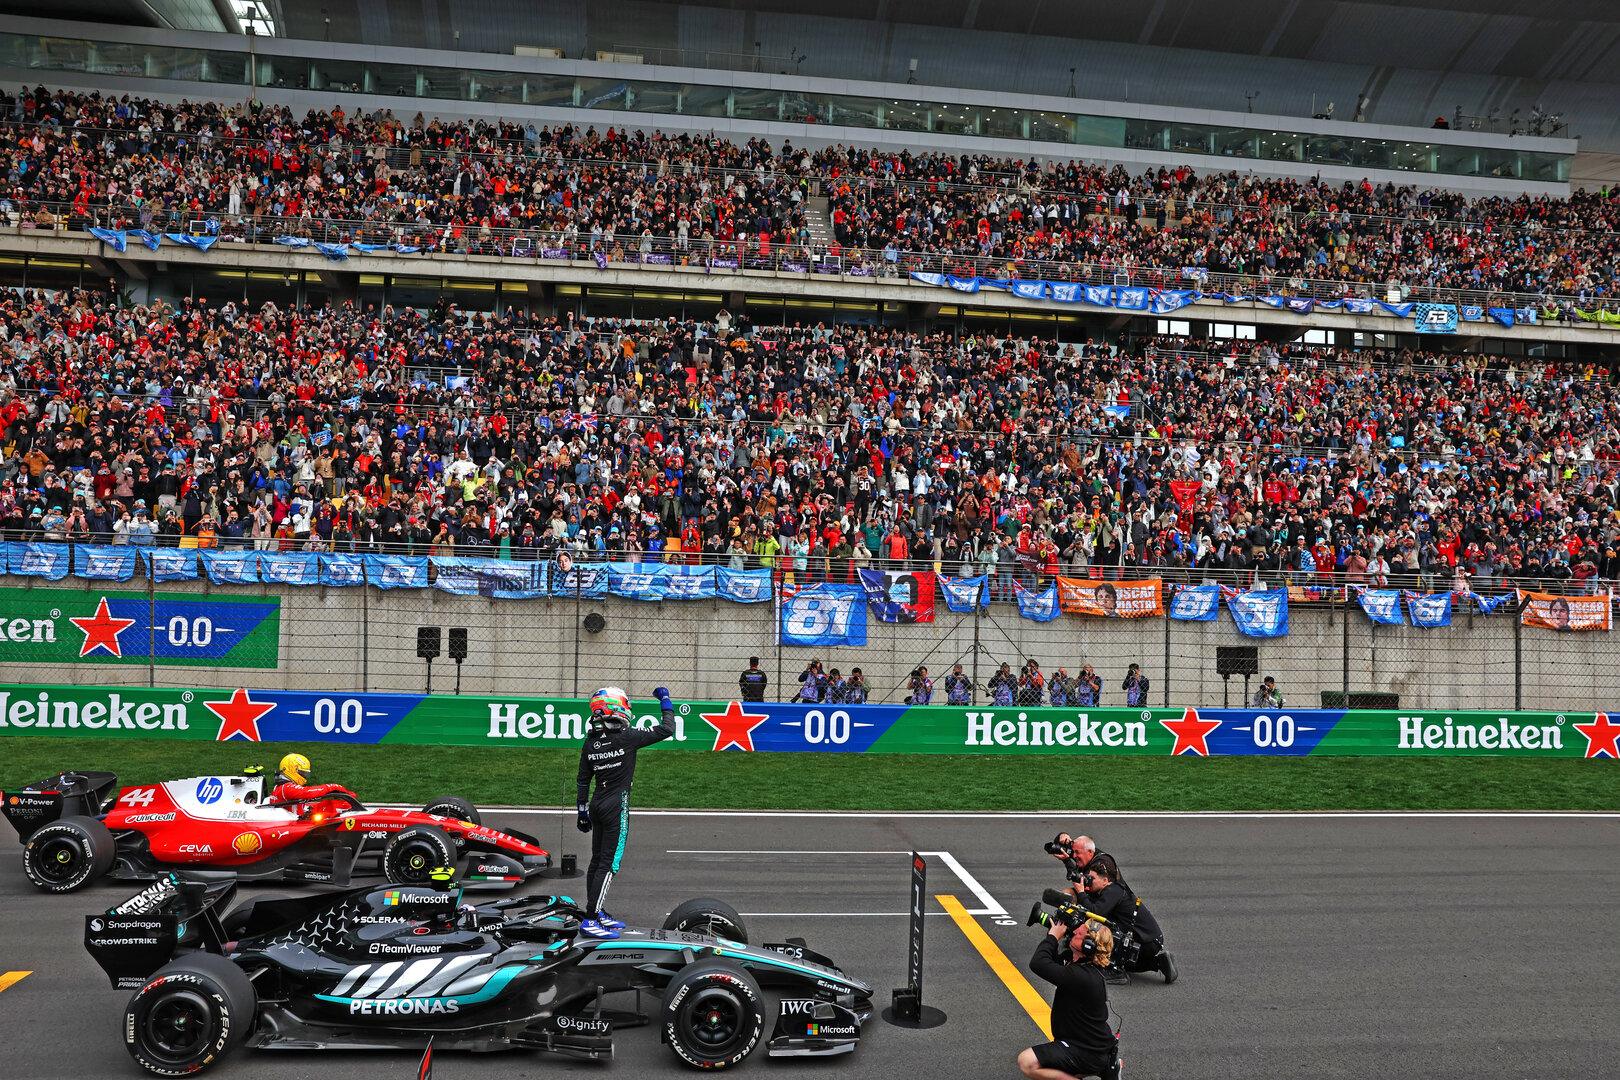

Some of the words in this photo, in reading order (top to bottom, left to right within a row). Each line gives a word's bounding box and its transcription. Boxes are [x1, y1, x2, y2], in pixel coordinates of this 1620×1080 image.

[1054, 285, 1077, 301] 81
[1120, 291, 1144, 306] 81
[1425, 310, 1448, 324] 63
[858, 480, 870, 491] 30
[270, 561, 306, 582] 63
[1036, 562, 1045, 570] 44
[563, 571, 597, 588] 63
[620, 574, 653, 591] 63
[727, 578, 761, 598] 63
[1115, 586, 1155, 599] OSCAR
[1115, 599, 1157, 612] PIASTRI
[1174, 591, 1213, 616] 81
[1413, 599, 1446, 622] 81
[788, 595, 855, 636] 81
[1236, 596, 1280, 630] 81
[168, 616, 212, 647] 0.0
[314, 699, 362, 734] 0.0
[804, 710, 850, 744] 0.0
[1254, 715, 1295, 748] 0.0
[588, 748, 625, 760] PETRONAS
[119, 788, 154, 807] 44
[199, 779, 221, 804] hp
[19, 798, 54, 806] V-Power
[136, 812, 176, 823] UniCredit
[227, 810, 248, 819] IBM
[401, 893, 449, 904] Microsoft
[108, 920, 162, 930] Snapdragon
[360, 916, 398, 924] SOLERA
[478, 924, 496, 933] AMD
[95, 937, 158, 945] CROWDSTRIKE
[380, 943, 442, 954] TeamViewer
[817, 979, 851, 994] Einhell
[669, 984, 690, 1011] PIRELLI
[350, 999, 460, 1015] PETRONAS
[780, 1000, 814, 1016] IWC
[127, 1013, 135, 1043] PIRELLI
[216, 1006, 230, 1050] ZERO
[820, 1025, 855, 1034] Microsoft
[732, 1027, 761, 1063] ZERO
